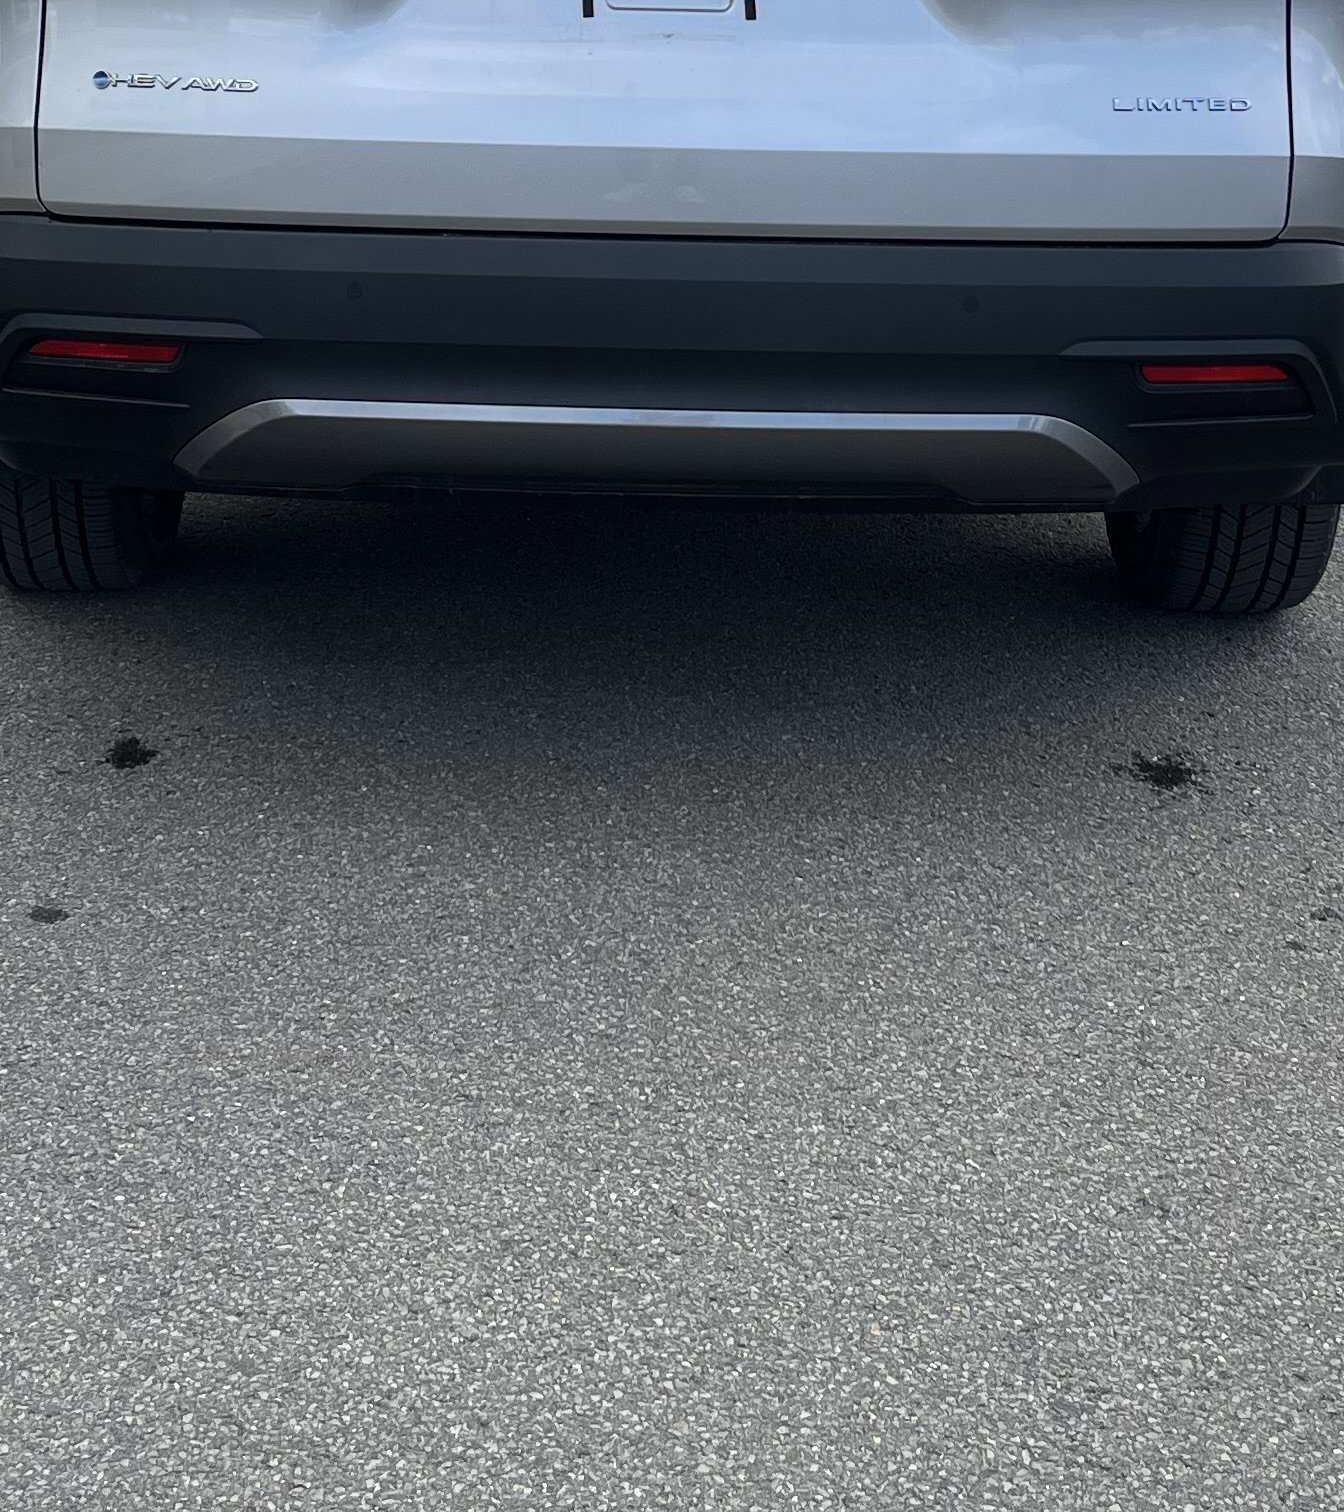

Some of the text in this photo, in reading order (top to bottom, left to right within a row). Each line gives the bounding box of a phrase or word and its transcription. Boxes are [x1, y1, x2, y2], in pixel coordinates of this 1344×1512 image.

[109, 73, 259, 92] HEV AWD
[1112, 97, 1253, 112] LIMITED
